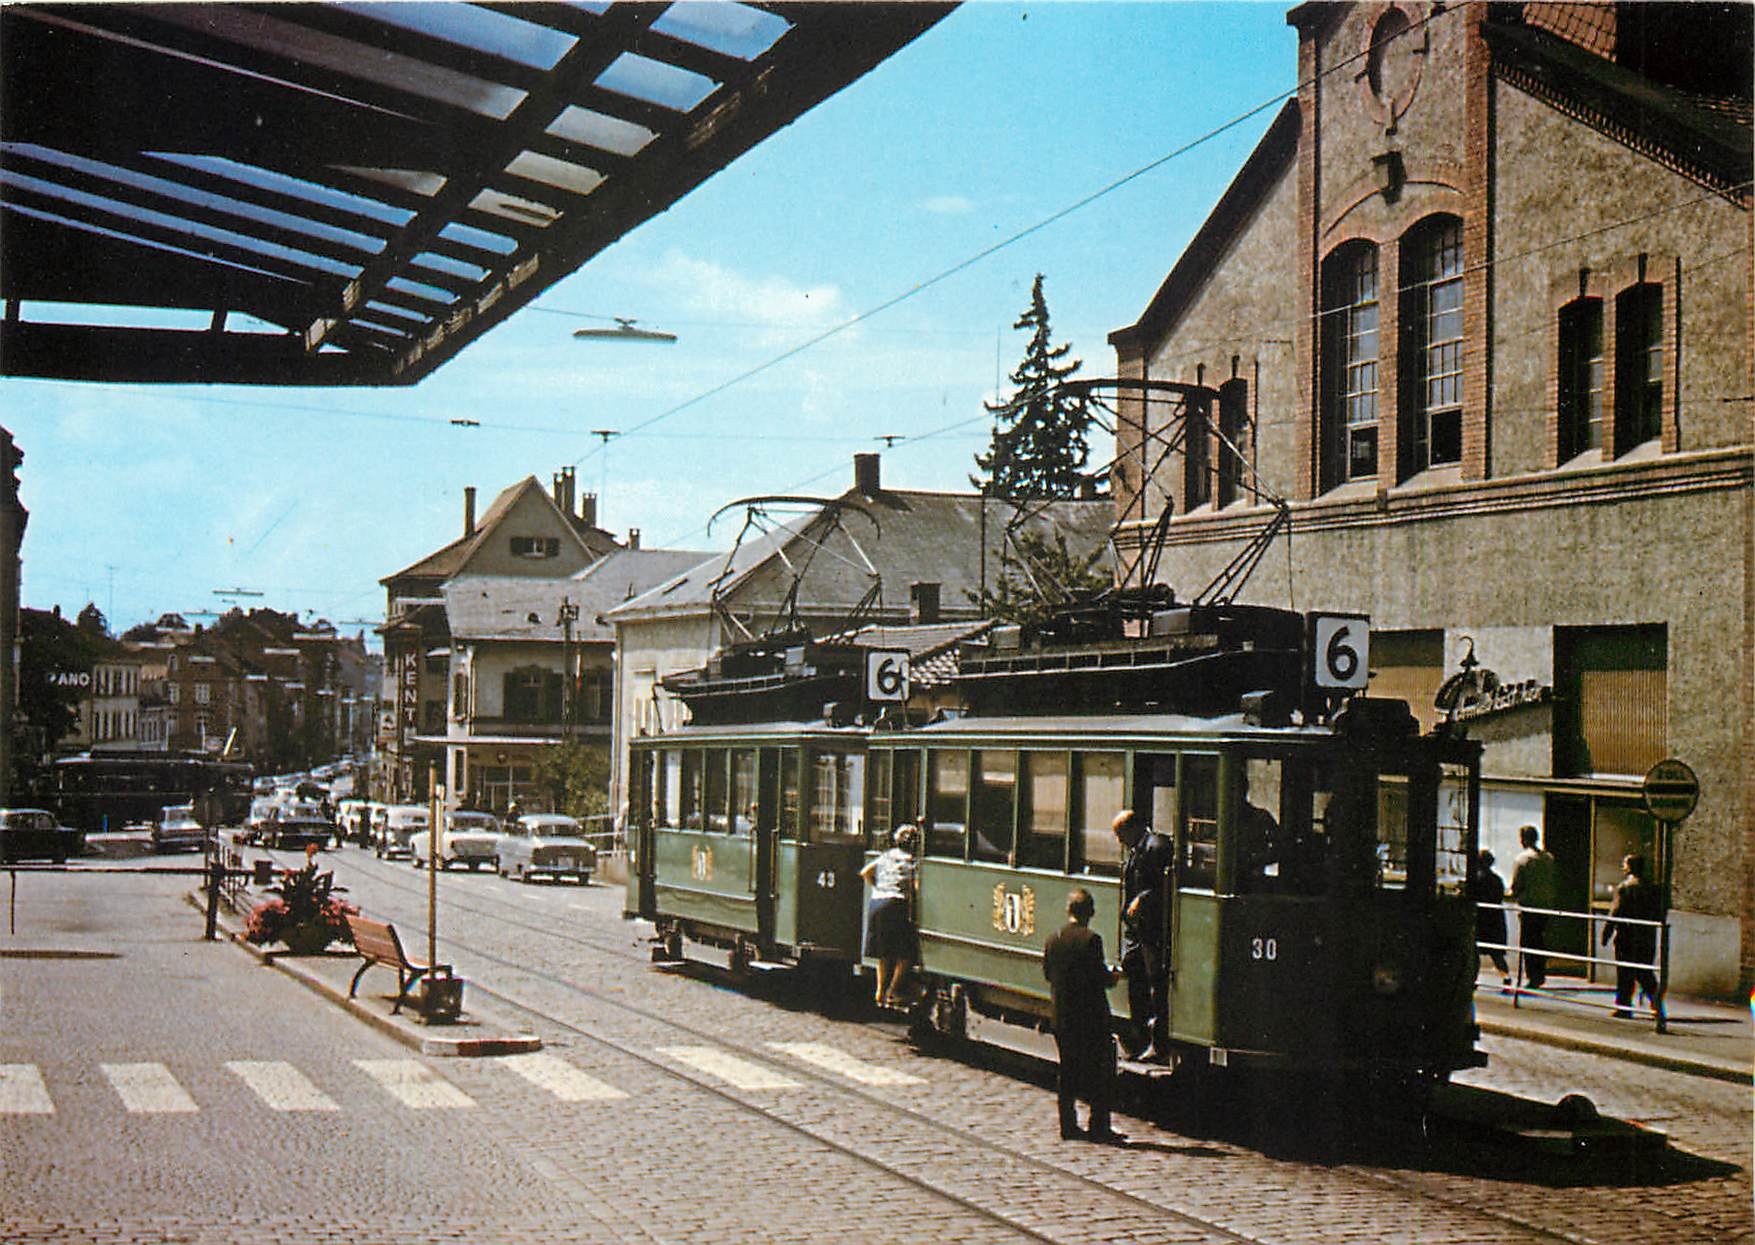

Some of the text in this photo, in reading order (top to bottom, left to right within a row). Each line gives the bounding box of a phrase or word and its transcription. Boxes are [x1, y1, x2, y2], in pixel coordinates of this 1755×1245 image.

[876, 657, 902, 696] 6
[1326, 626, 1359, 681] 6
[404, 652, 418, 721] KENT
[1251, 937, 1278, 960] 30
